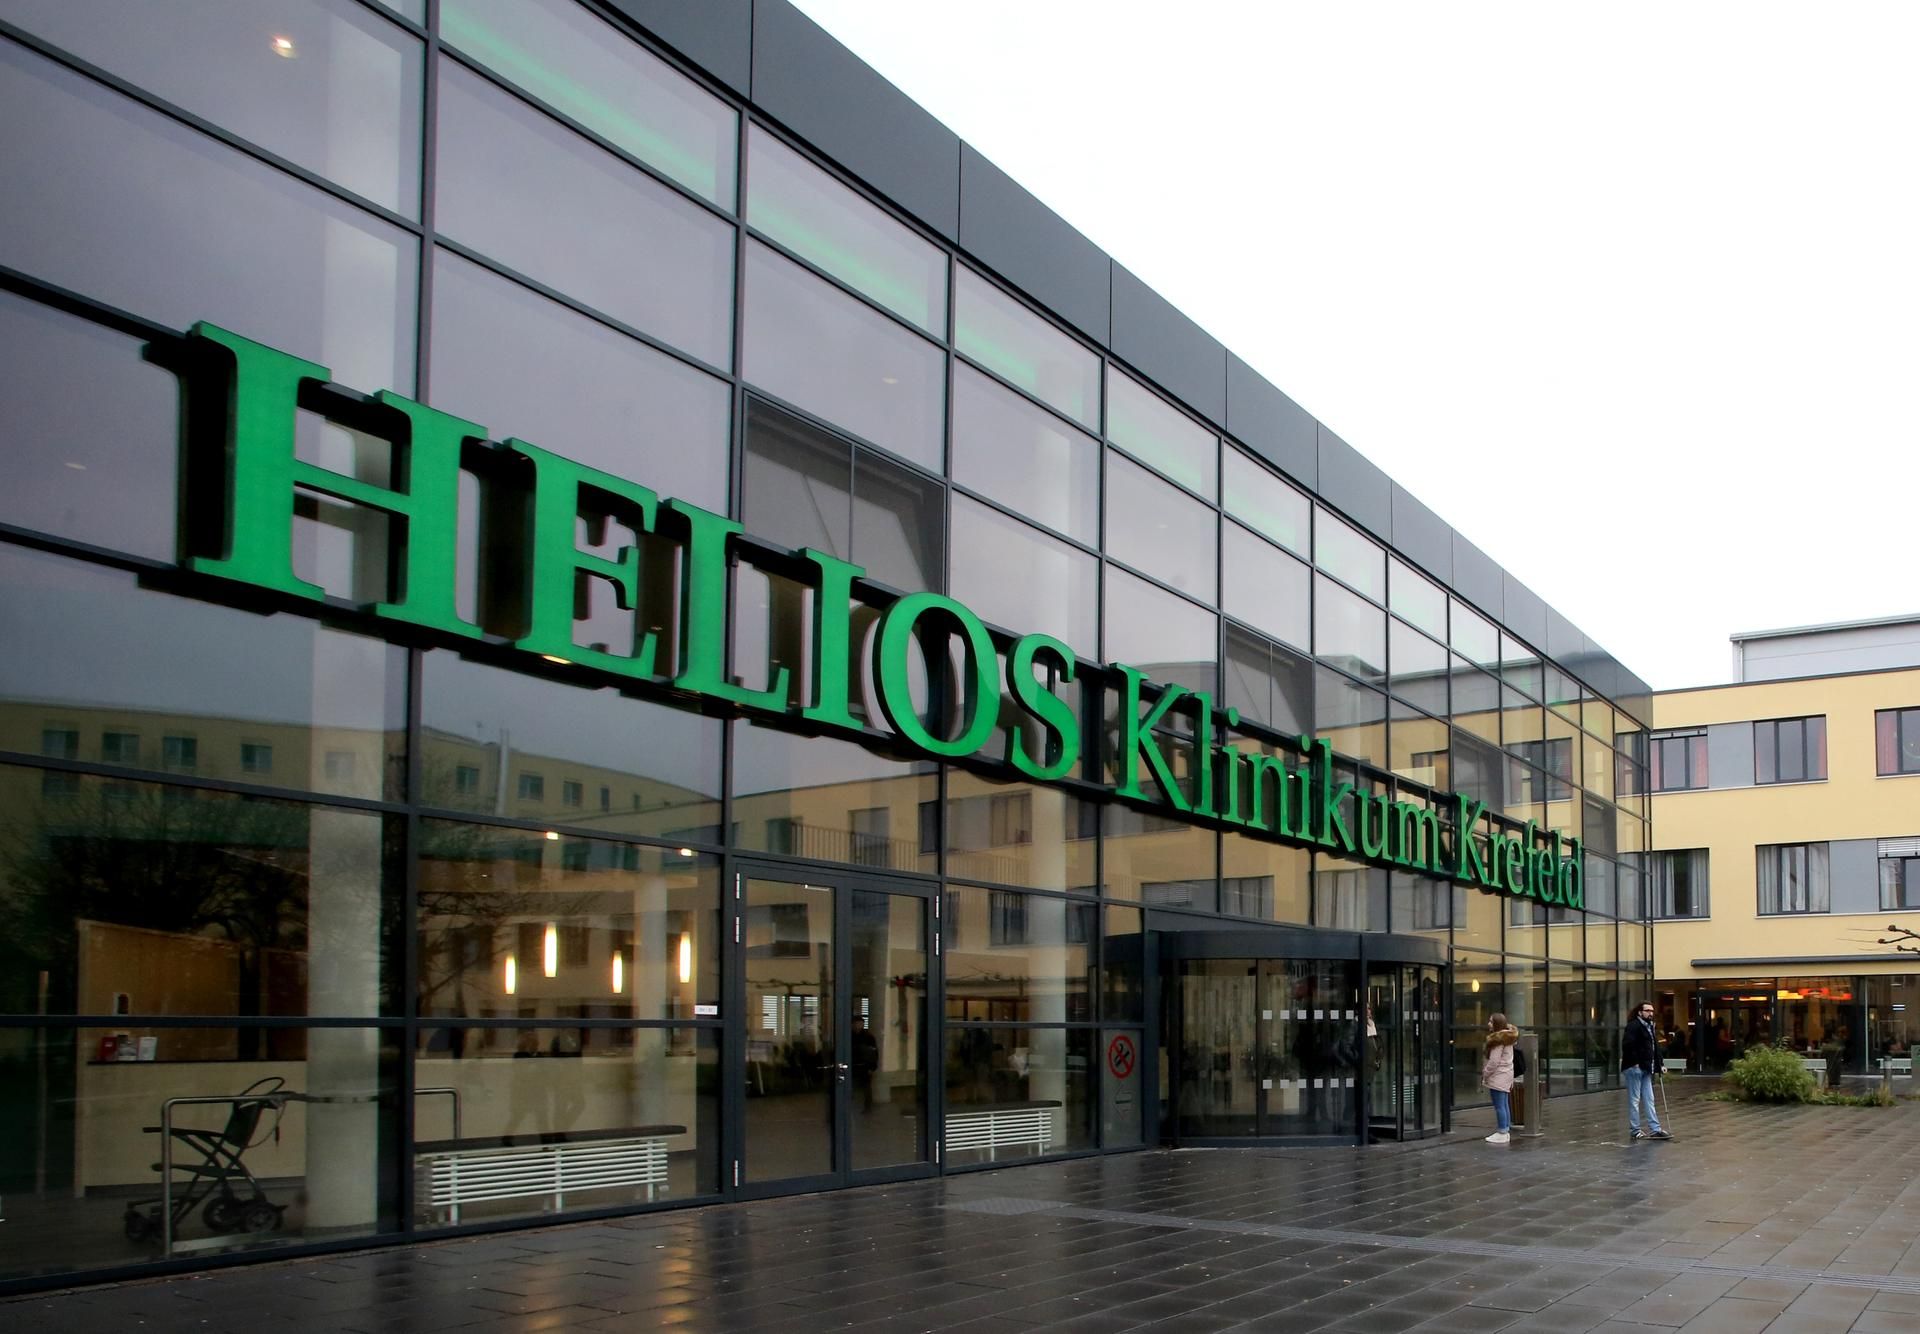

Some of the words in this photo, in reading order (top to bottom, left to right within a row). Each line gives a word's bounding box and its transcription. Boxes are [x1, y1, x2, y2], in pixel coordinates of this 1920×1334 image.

[191, 321, 1082, 781] HELIOS
[1110, 663, 1443, 873] Klinikum
[1455, 793, 1584, 908] Krefeld
